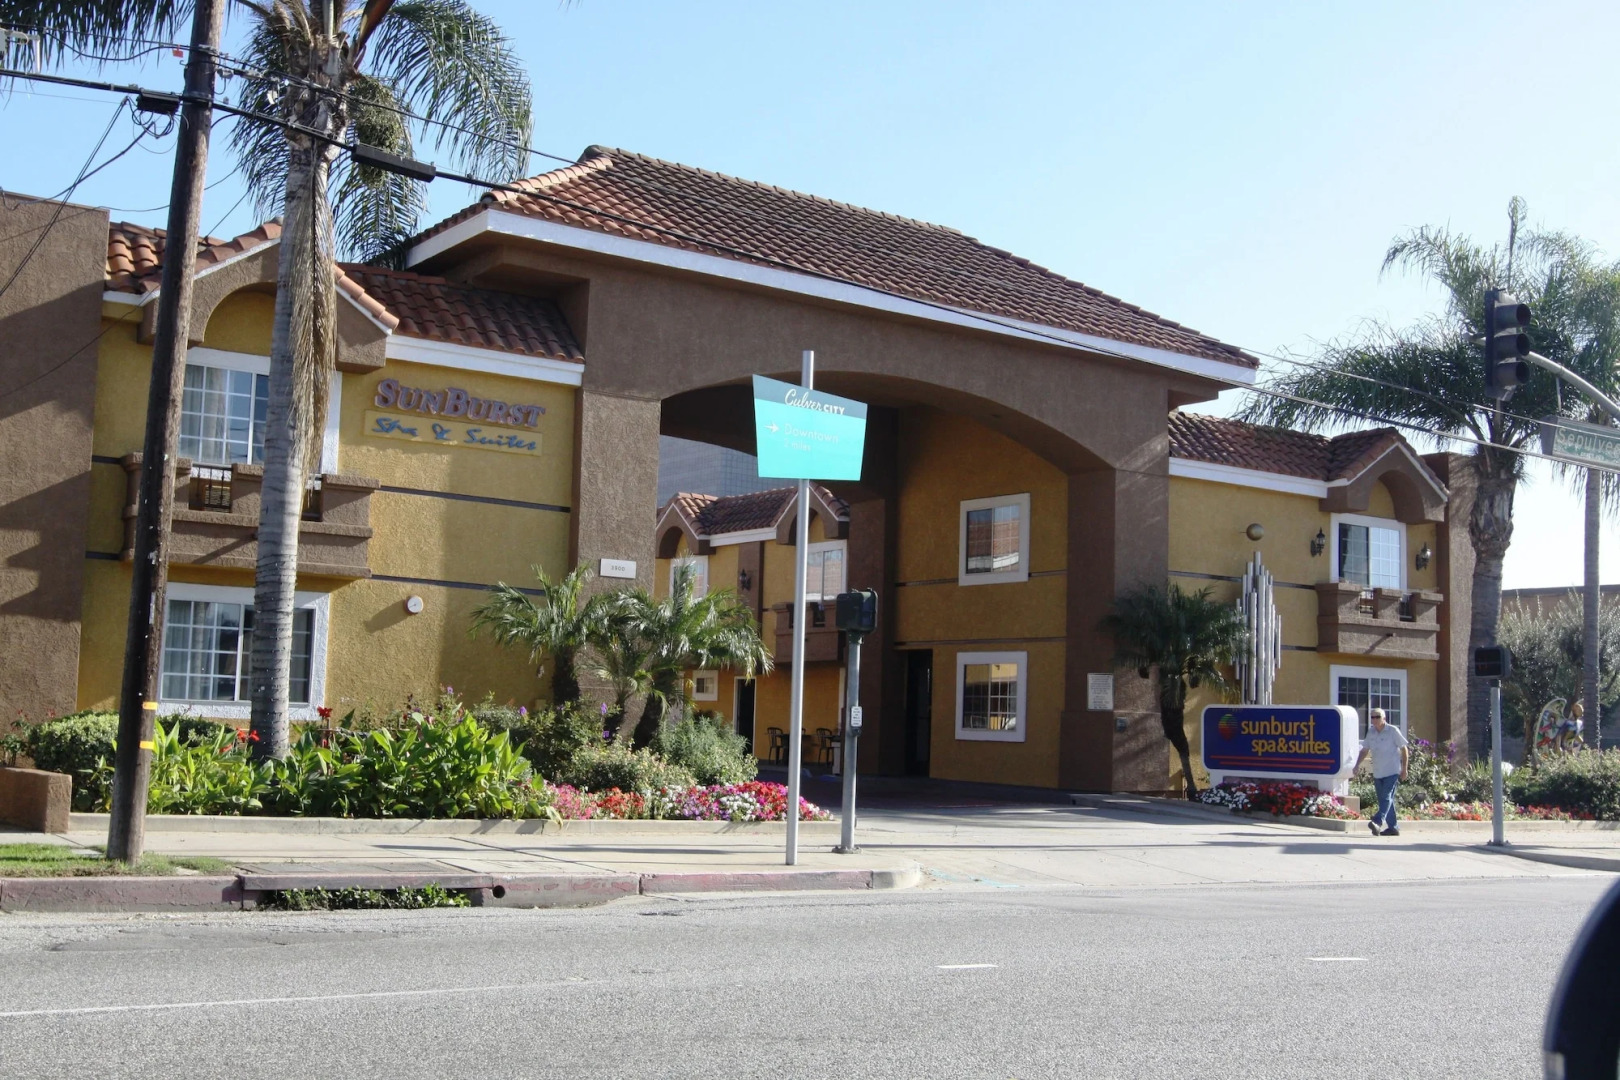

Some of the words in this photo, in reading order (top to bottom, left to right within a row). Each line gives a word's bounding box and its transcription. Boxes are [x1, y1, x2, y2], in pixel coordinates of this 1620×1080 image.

[823, 404, 845, 415] CITY
[431, 423, 452, 440] &
[463, 428, 537, 450] Suites
[784, 423, 839, 443] Downtown
[791, 440, 812, 452] miles
[1241, 714, 1316, 739] sunburst
